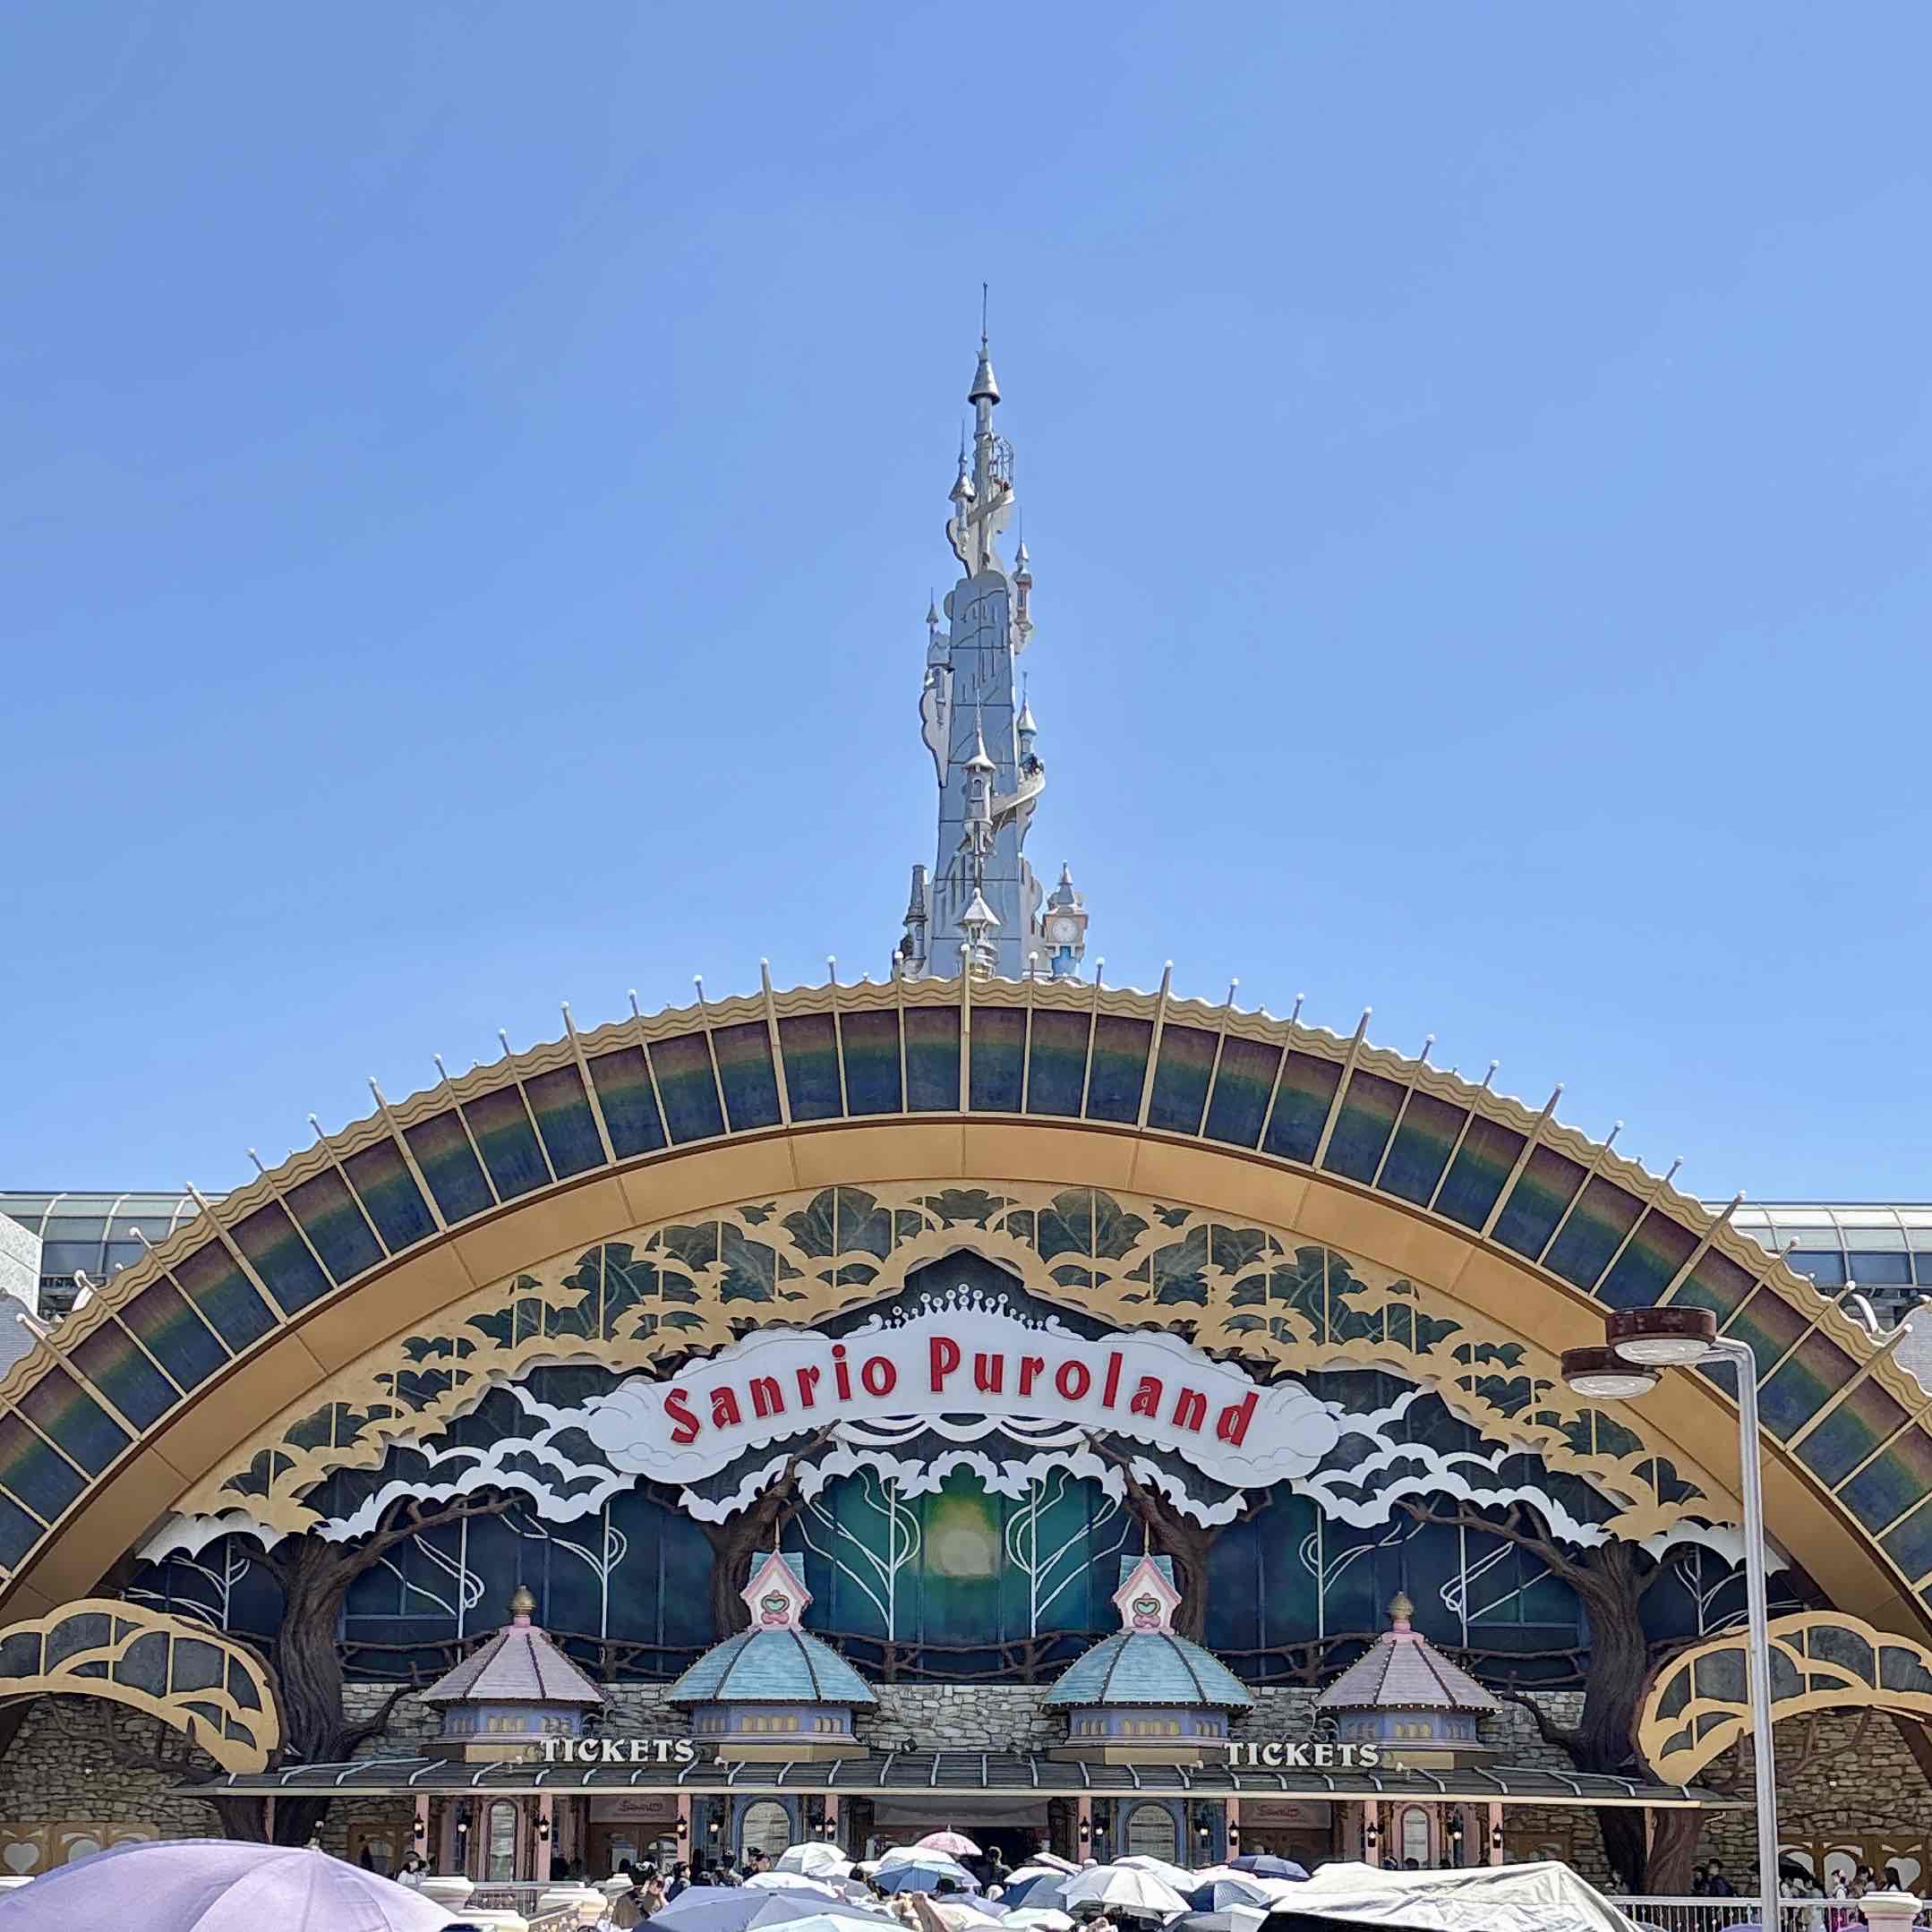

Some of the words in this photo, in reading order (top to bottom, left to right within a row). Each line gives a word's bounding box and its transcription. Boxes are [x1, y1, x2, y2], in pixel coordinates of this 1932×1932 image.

[663, 1345, 898, 1443] Sanrio
[929, 1336, 1260, 1448] Puroland
[540, 1738, 695, 1762] TICKETS
[1224, 1742, 1380, 1767] TICKETS
